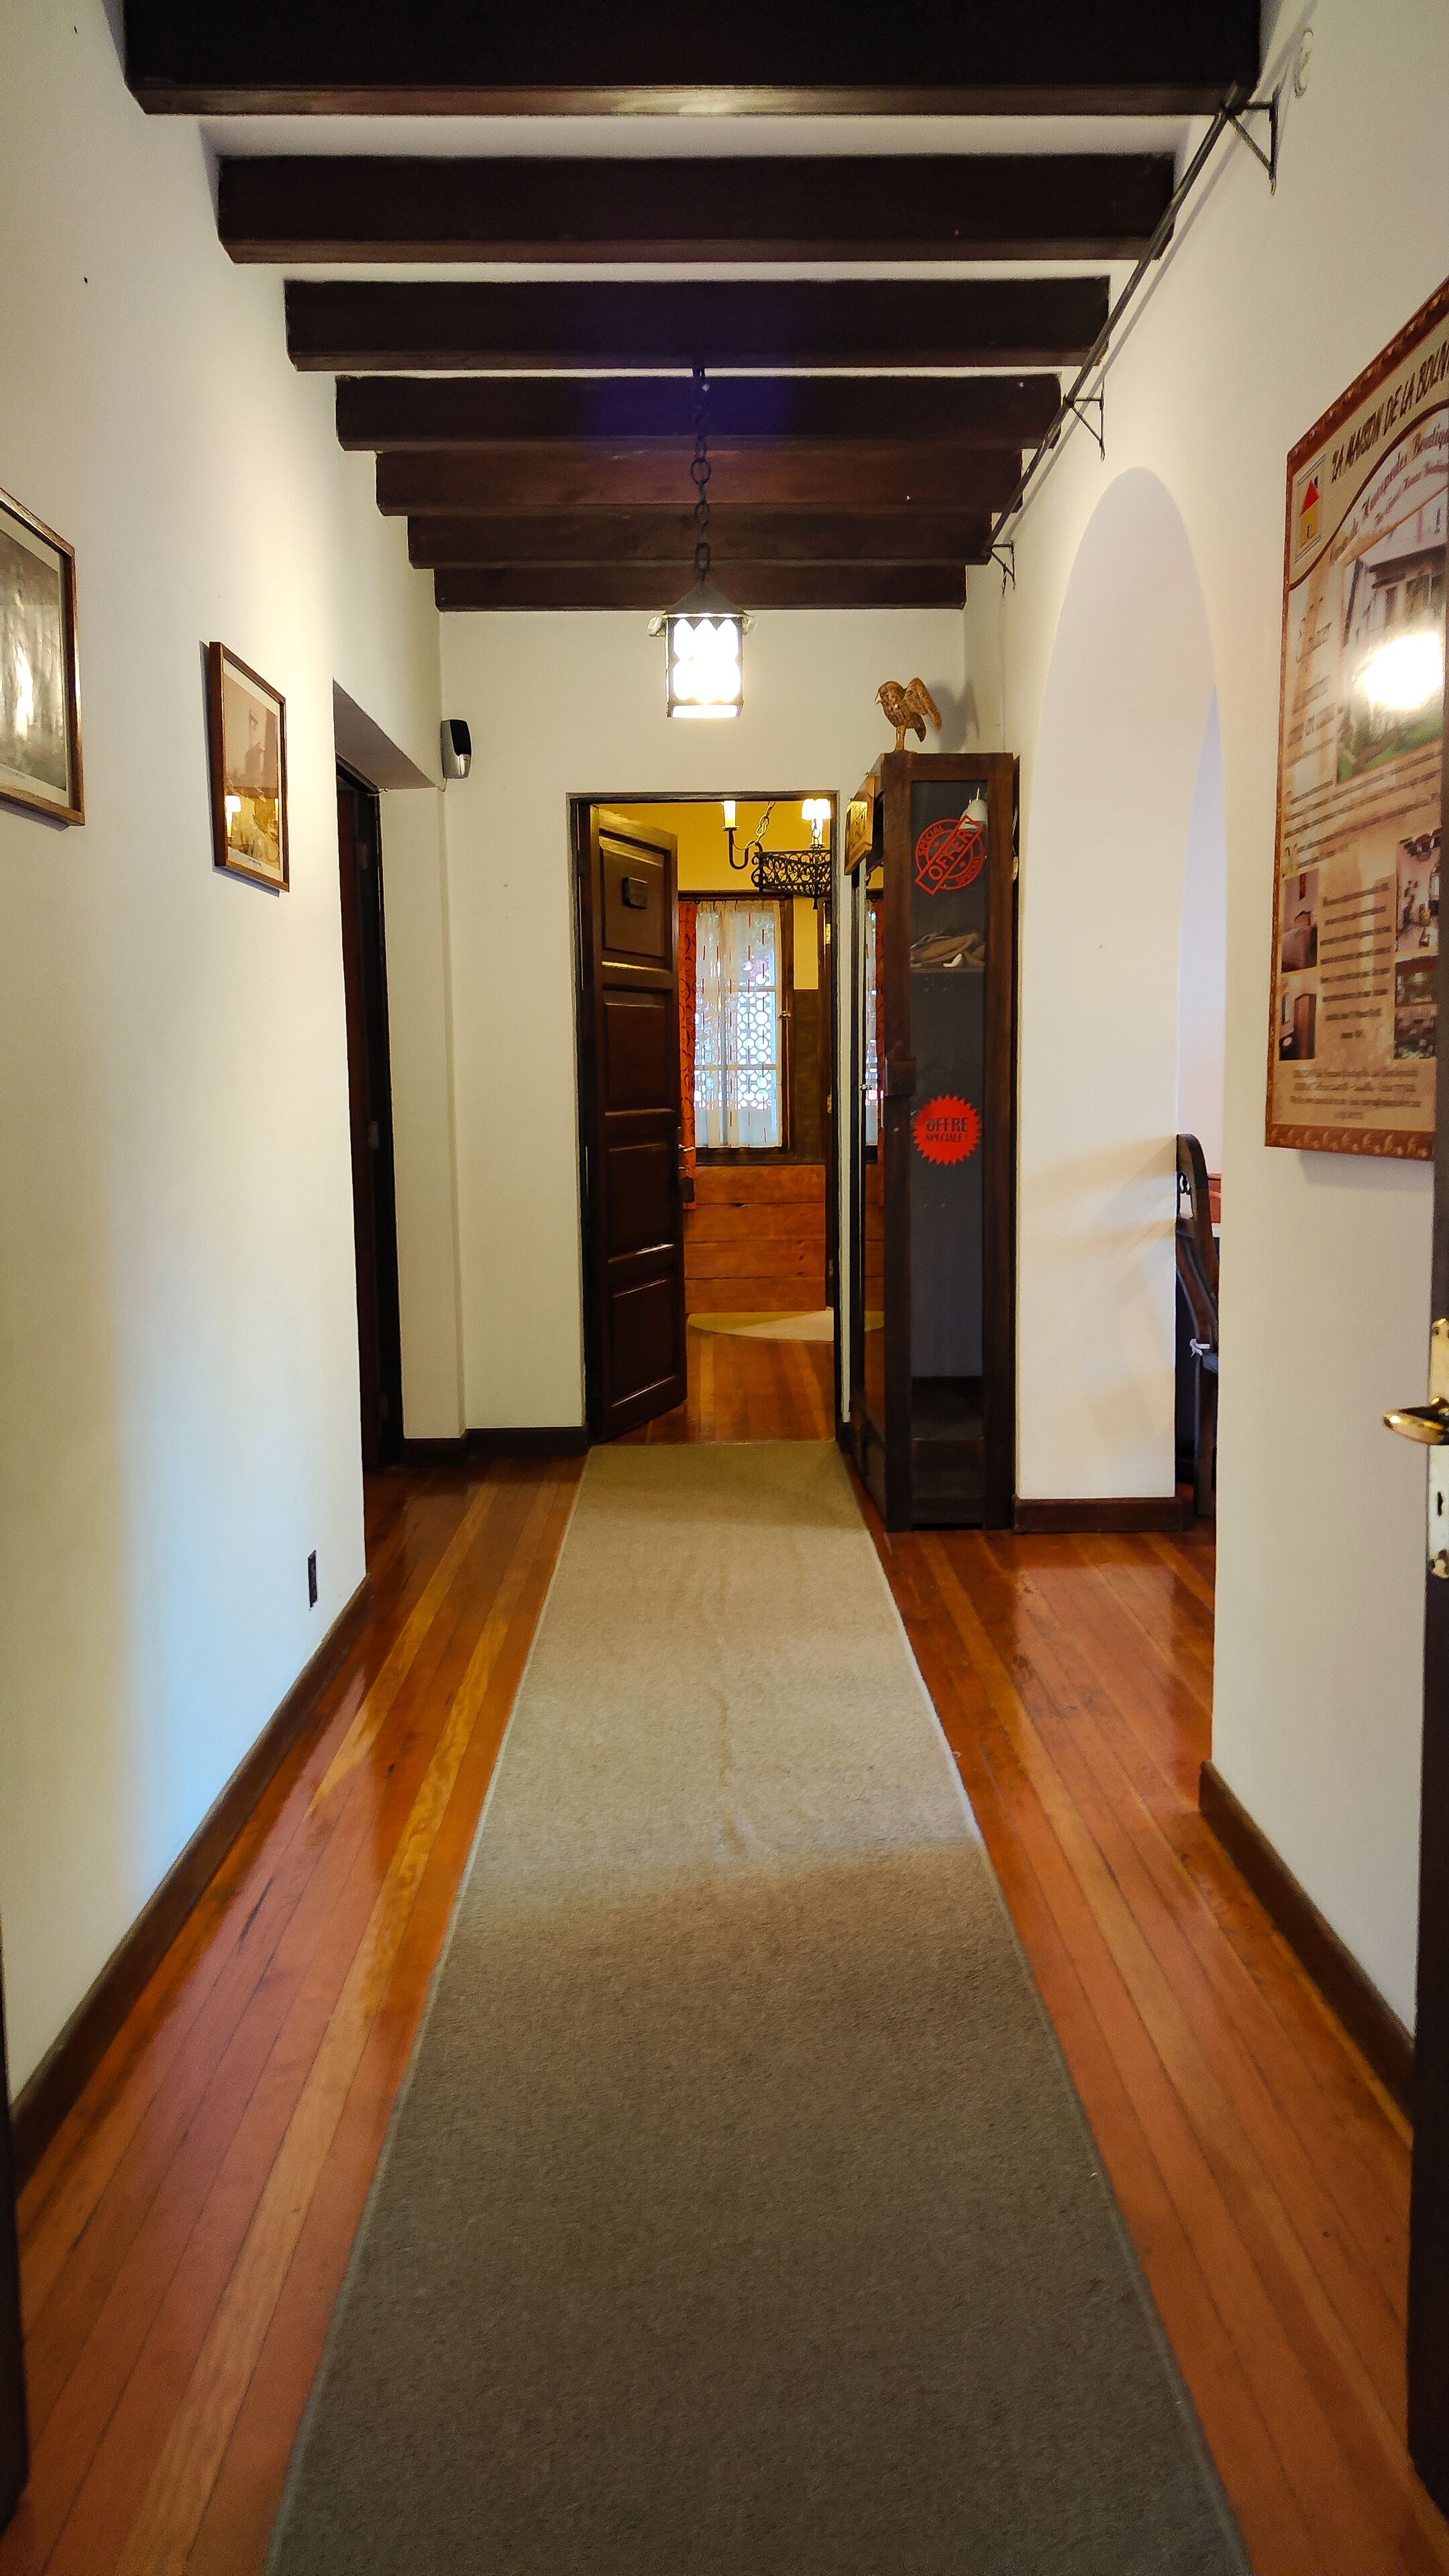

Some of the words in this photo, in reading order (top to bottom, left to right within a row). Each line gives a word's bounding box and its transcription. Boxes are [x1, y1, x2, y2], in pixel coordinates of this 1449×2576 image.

[1383, 384, 1403, 436] DE
[1399, 372, 1415, 419] LA
[928, 830, 973, 880] OFFER
[926, 1117, 968, 1132] OFFRE
